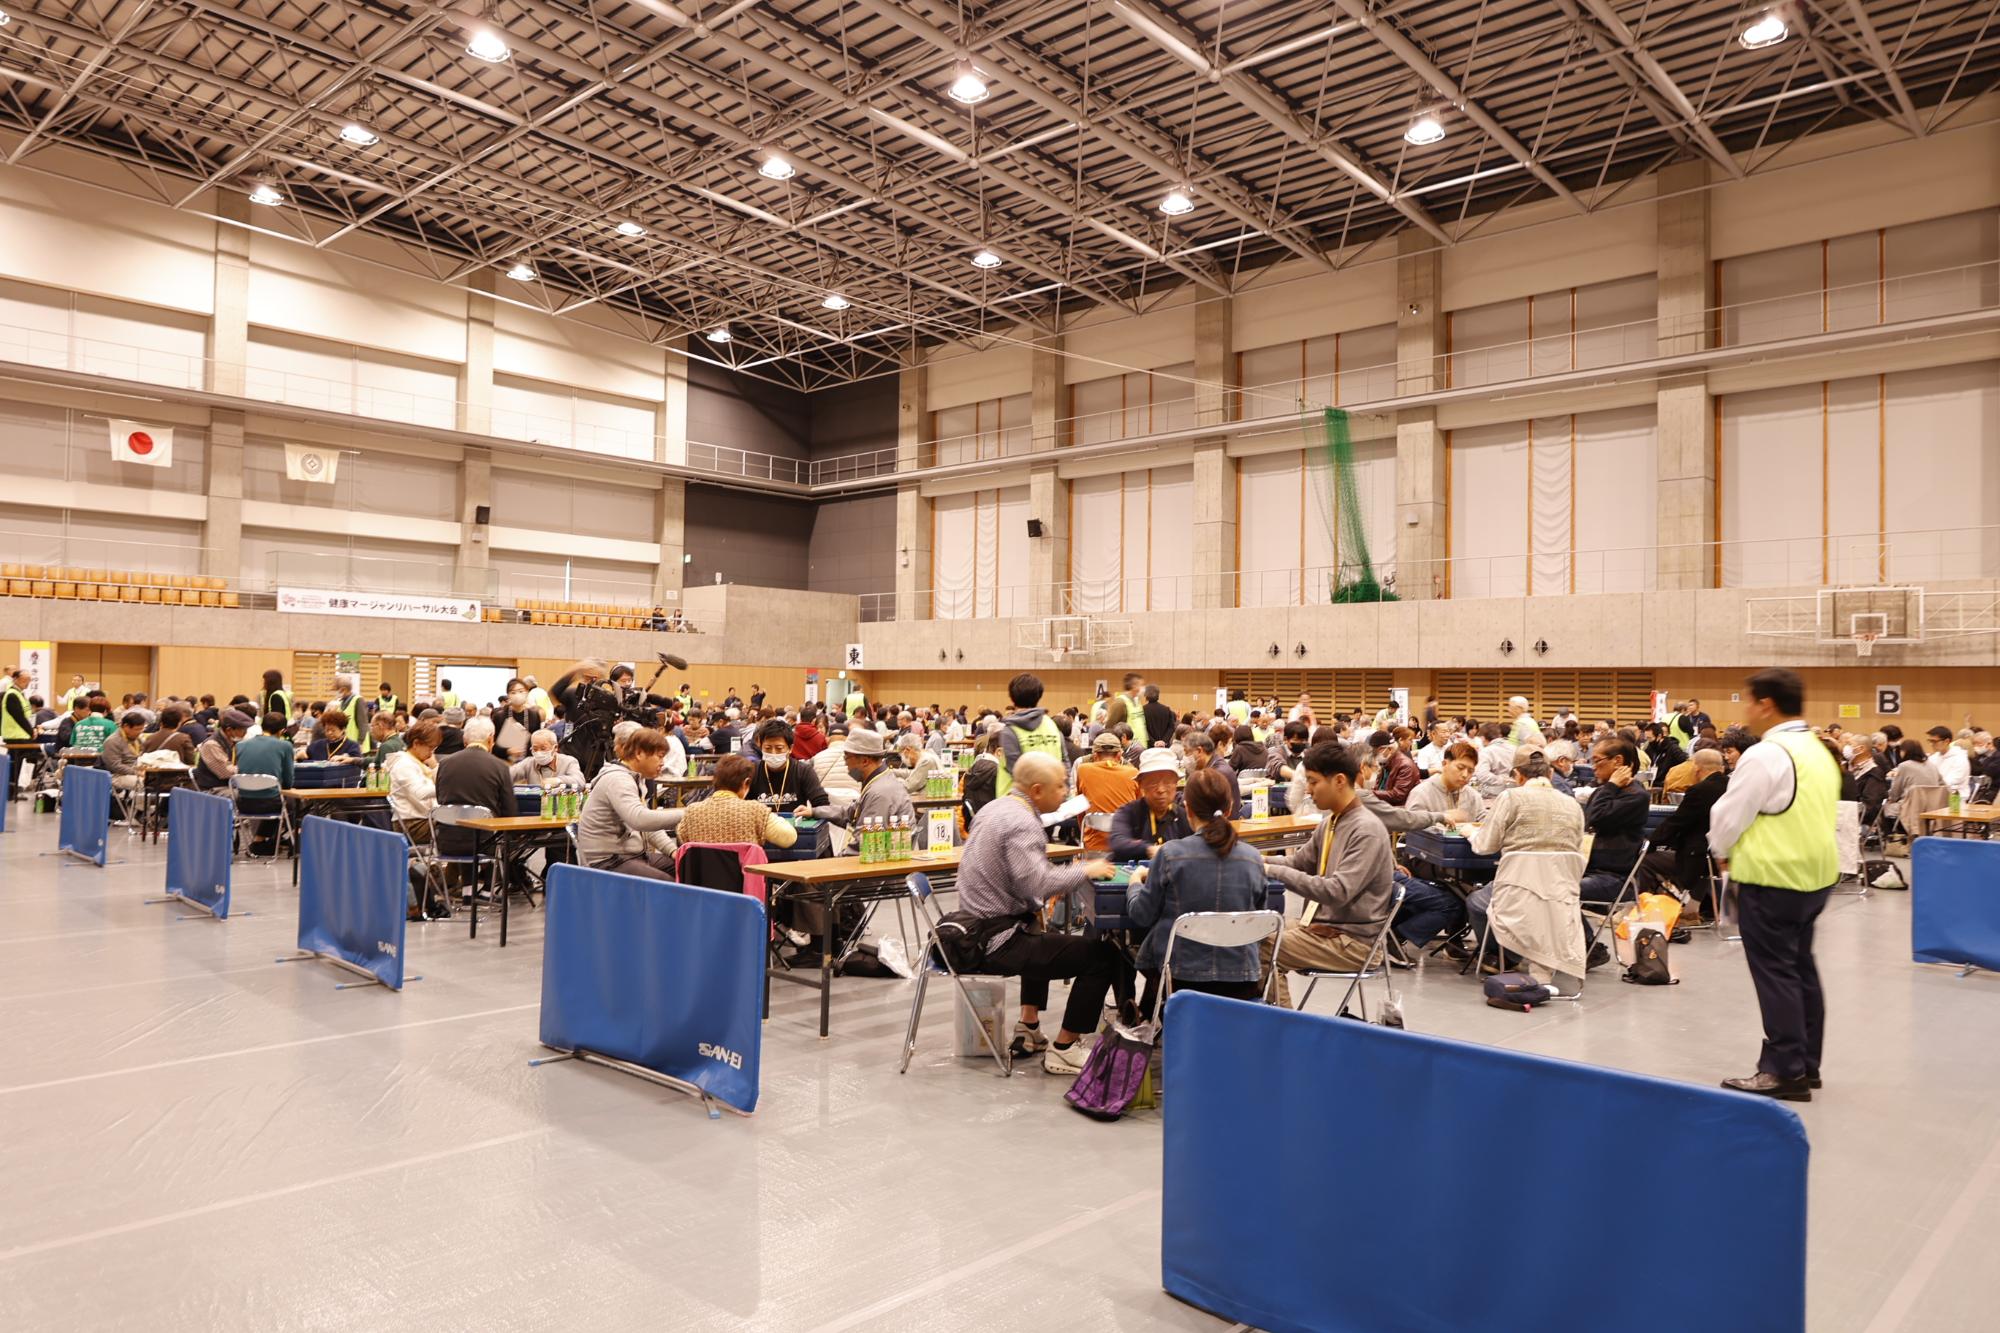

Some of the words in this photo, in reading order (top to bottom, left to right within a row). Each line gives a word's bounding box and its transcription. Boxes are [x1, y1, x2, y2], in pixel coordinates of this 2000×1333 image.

[328, 598, 458, 615] 健康マージャンリハーサル大会
[848, 647, 861, 666] 東
[1096, 683, 1106, 699] A
[1879, 690, 1900, 713] B
